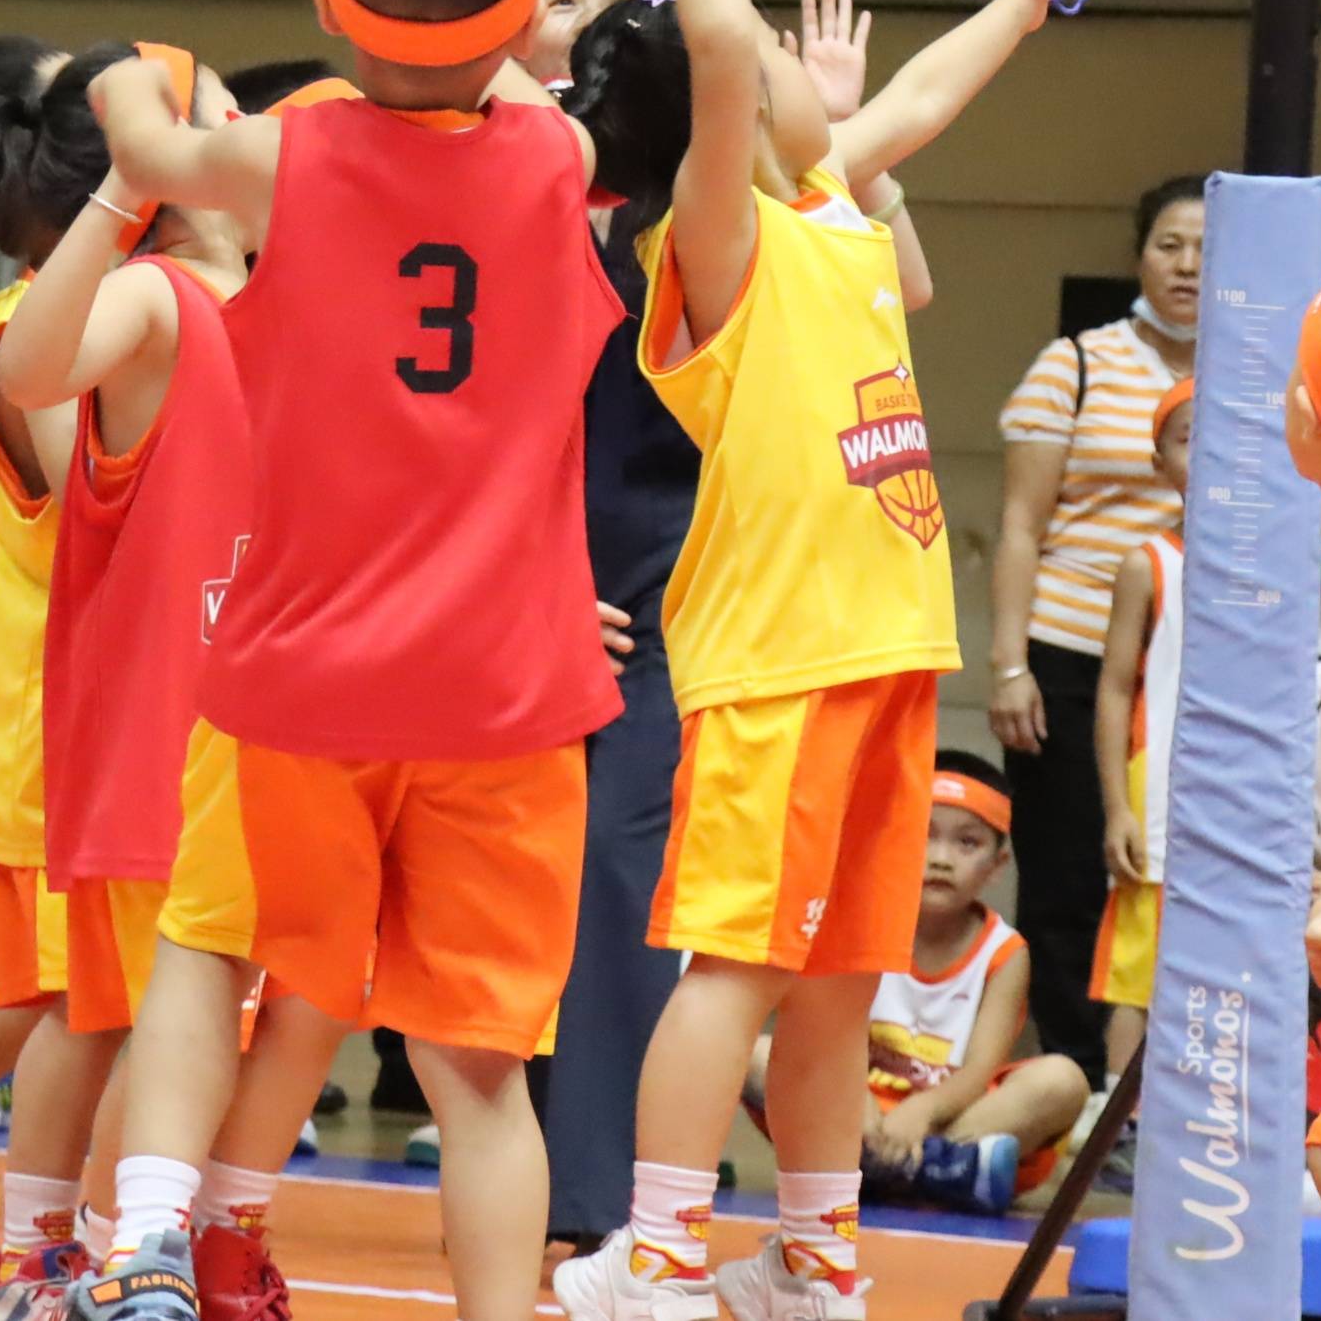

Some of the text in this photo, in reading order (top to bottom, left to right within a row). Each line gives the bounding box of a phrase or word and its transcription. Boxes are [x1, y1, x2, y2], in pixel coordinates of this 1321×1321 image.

[394, 242, 479, 394] 3
[1215, 288, 1247, 304] 1100
[1177, 984, 1208, 1076] Sports
[1175, 990, 1251, 1261] Walmonos
